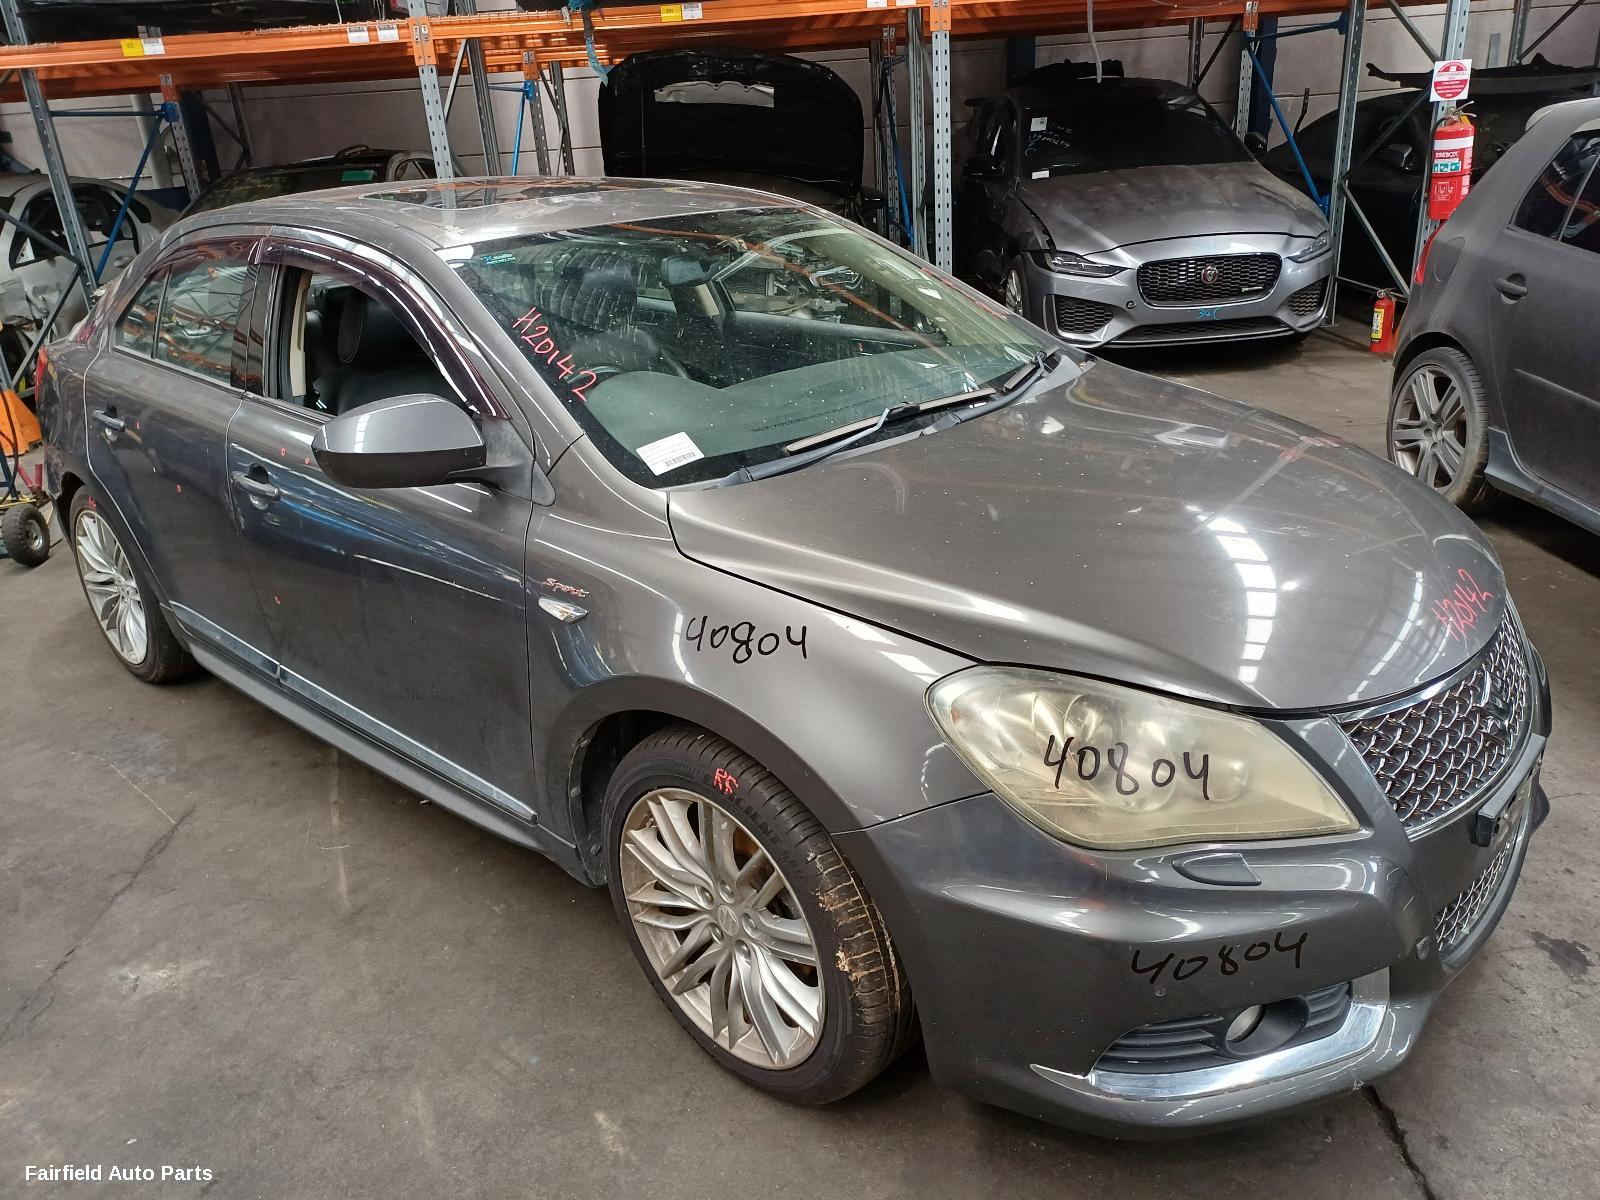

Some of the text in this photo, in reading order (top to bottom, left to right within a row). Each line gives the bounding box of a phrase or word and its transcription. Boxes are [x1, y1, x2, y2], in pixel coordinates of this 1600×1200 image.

[512, 306, 597, 402] H20142
[686, 615, 808, 664] 40804
[1043, 734, 1210, 800] 40804
[1131, 931, 1308, 984] 40804
